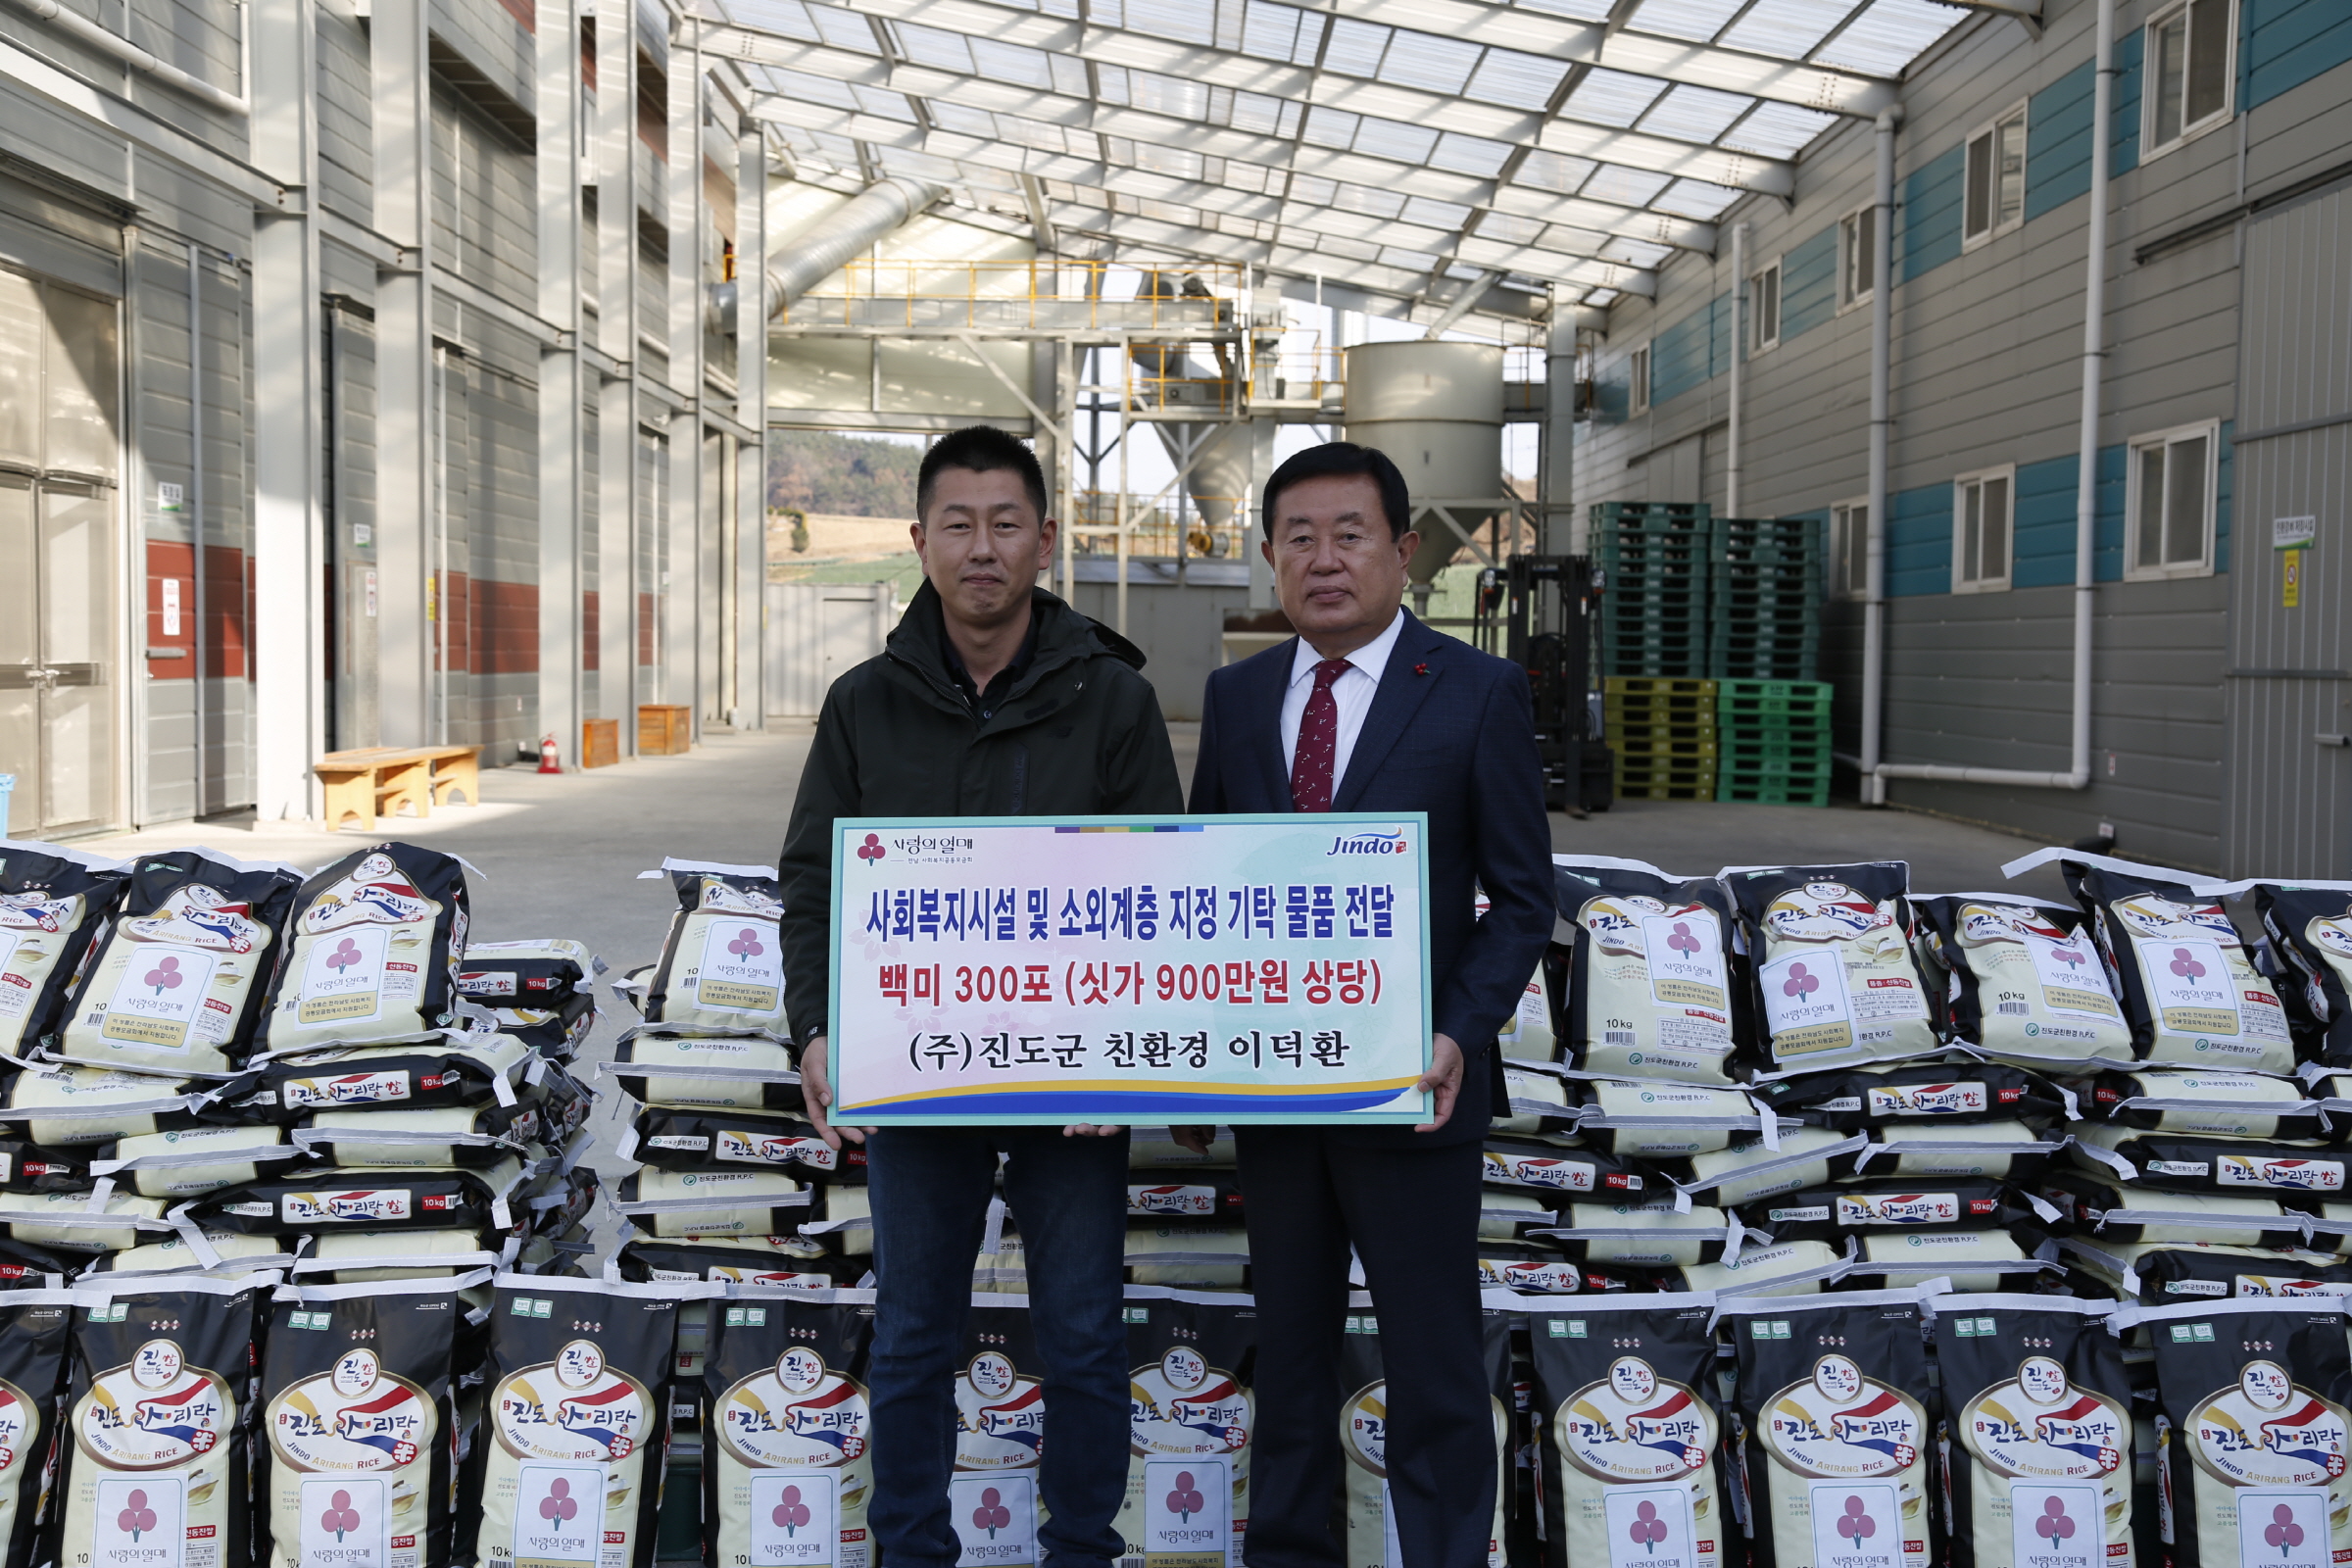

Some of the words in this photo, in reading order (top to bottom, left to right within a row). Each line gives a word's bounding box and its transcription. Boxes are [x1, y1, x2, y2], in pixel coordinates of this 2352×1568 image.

[890, 835, 937, 855] 사랑의
[940, 835, 973, 855] 열매
[1326, 836, 1394, 856] Jindo
[865, 888, 1016, 943] 사회복지시설
[1028, 887, 1051, 940] 및
[1058, 886, 1159, 942] 소외계층
[1168, 886, 1219, 941] 지정
[1228, 885, 1277, 938] 기탁
[1286, 886, 1336, 939] 물품
[1345, 885, 1395, 939] 전달
[1603, 936, 1625, 945] JINDO
[714, 964, 746, 976] 사랑의
[879, 964, 941, 1006] 백미
[955, 965, 1053, 1004] 300포
[1066, 960, 1145, 1006] (싯가
[1156, 960, 1289, 1005] 900만원
[1302, 959, 1382, 1006] 상당)
[124, 998, 158, 1009] 사랑의
[1998, 992, 2011, 1002] 10
[2012, 992, 2025, 1001] kg
[2170, 990, 2200, 1001] 사랑의
[1781, 1007, 1810, 1021] 사랑의
[1606, 1019, 1618, 1028] 10
[1619, 1019, 1633, 1029] kg
[2041, 1027, 2078, 1037] 진도군친환경
[2080, 1030, 2096, 1039] R.P.C
[694, 1043, 731, 1052] 진도군친환경
[909, 1031, 1088, 1071] (주)진도군
[1103, 1032, 1209, 1070] 친환경
[1228, 1031, 1350, 1070] 이덕환
[2210, 1043, 2244, 1054] 진도군친환경
[1644, 1056, 1680, 1067] 진도군친환경
[385, 1081, 404, 1096] 쌀
[1883, 1097, 1909, 1109] 진도
[1913, 1093, 1960, 1107] 아리랑
[1963, 1092, 1981, 1106] 쌀
[730, 1141, 756, 1156] 진도
[814, 1149, 831, 1164] 쌀
[699, 1175, 735, 1184] 진도군친환경
[1486, 1162, 1510, 1177] 진도
[1517, 1168, 1569, 1185] 아리랑
[1572, 1172, 1588, 1187] 쌀
[2231, 1165, 2258, 1181] 진도
[2264, 1169, 2319, 1187] 아리랑
[2321, 1171, 2338, 1186] 쌀
[297, 1203, 324, 1217] 진도
[330, 1200, 383, 1218] 아리랑
[386, 1200, 404, 1214] 쌀
[1193, 1195, 1209, 1209] 쌀
[1849, 1205, 1875, 1219] 진도
[1882, 1204, 1933, 1220] 아리랑
[1936, 1202, 1953, 1218] 쌀
[1923, 1236, 1960, 1245] 진도군친환경
[97, 1405, 124, 1429] 진도
[134, 1402, 218, 1428] 아리랑
[513, 1401, 548, 1424] 진도
[559, 1403, 637, 1435] 아리랑
[1131, 1401, 1163, 1422] 진도
[1172, 1405, 1243, 1425] 아리랑
[290, 1413, 327, 1437] 진도
[336, 1414, 418, 1440] 아리랑
[739, 1410, 776, 1434] 진도
[785, 1410, 863, 1435] 아리랑
[1785, 1419, 1825, 1442] 진도
[1834, 1419, 1912, 1443] 아리랑
[1580, 1422, 1619, 1445] 진도
[1629, 1421, 1700, 1445] 아리랑
[1986, 1421, 2029, 1444] 진도
[2038, 1421, 2115, 1446] 아리랑
[2212, 1429, 2255, 1451] 진도
[2264, 1428, 2342, 1452] 아리랑
[91, 1434, 112, 1452] JINDO
[111, 1447, 151, 1461] ARIRANG
[154, 1446, 178, 1460] RICE
[508, 1428, 530, 1447] JINDO
[531, 1446, 571, 1460] ARIRANG
[574, 1448, 597, 1460] RICE
[736, 1438, 761, 1456] JINDO
[763, 1452, 806, 1465] ARIRANG
[808, 1452, 831, 1464] RICE
[1151, 1442, 1192, 1454] ARIRANG
[1195, 1443, 1215, 1453] RICE
[287, 1442, 311, 1461] JINDO
[312, 1456, 354, 1470] ARIRANG
[357, 1457, 380, 1470] RICE
[958, 1452, 1000, 1465] ARIRANG
[1004, 1452, 1025, 1465] RICE
[1582, 1449, 1608, 1468] JINDO
[1610, 1463, 1652, 1475] ARIRANG
[1655, 1462, 1676, 1474] RICE
[1787, 1446, 1813, 1466] JINDO
[1816, 1460, 1859, 1473] ARIRANG
[1862, 1460, 1885, 1472] RICE
[1989, 1448, 2016, 1467] JINDO
[2019, 1463, 2063, 1476] ARIRANG
[2067, 1464, 2089, 1476] RICE
[2215, 1456, 2243, 1476] JINDO
[2246, 1472, 2290, 1484] ARIRANG
[2293, 1471, 2317, 1484] RICE
[527, 1537, 560, 1550] 사랑의
[562, 1538, 585, 1551] 열매
[1156, 1530, 1189, 1544] 사랑의
[1191, 1530, 1214, 1544] 열매
[76, 1553, 89, 1564] 10
[107, 1548, 140, 1565] 사랑의
[141, 1548, 167, 1564] 열매
[311, 1549, 344, 1564] 사랑의
[346, 1548, 370, 1563] 열매
[491, 1546, 503, 1556] 10
[762, 1544, 795, 1558] 사랑의
[797, 1544, 820, 1557] 열매
[965, 1545, 997, 1560] 사랑의
[999, 1544, 1022, 1558] 열매
